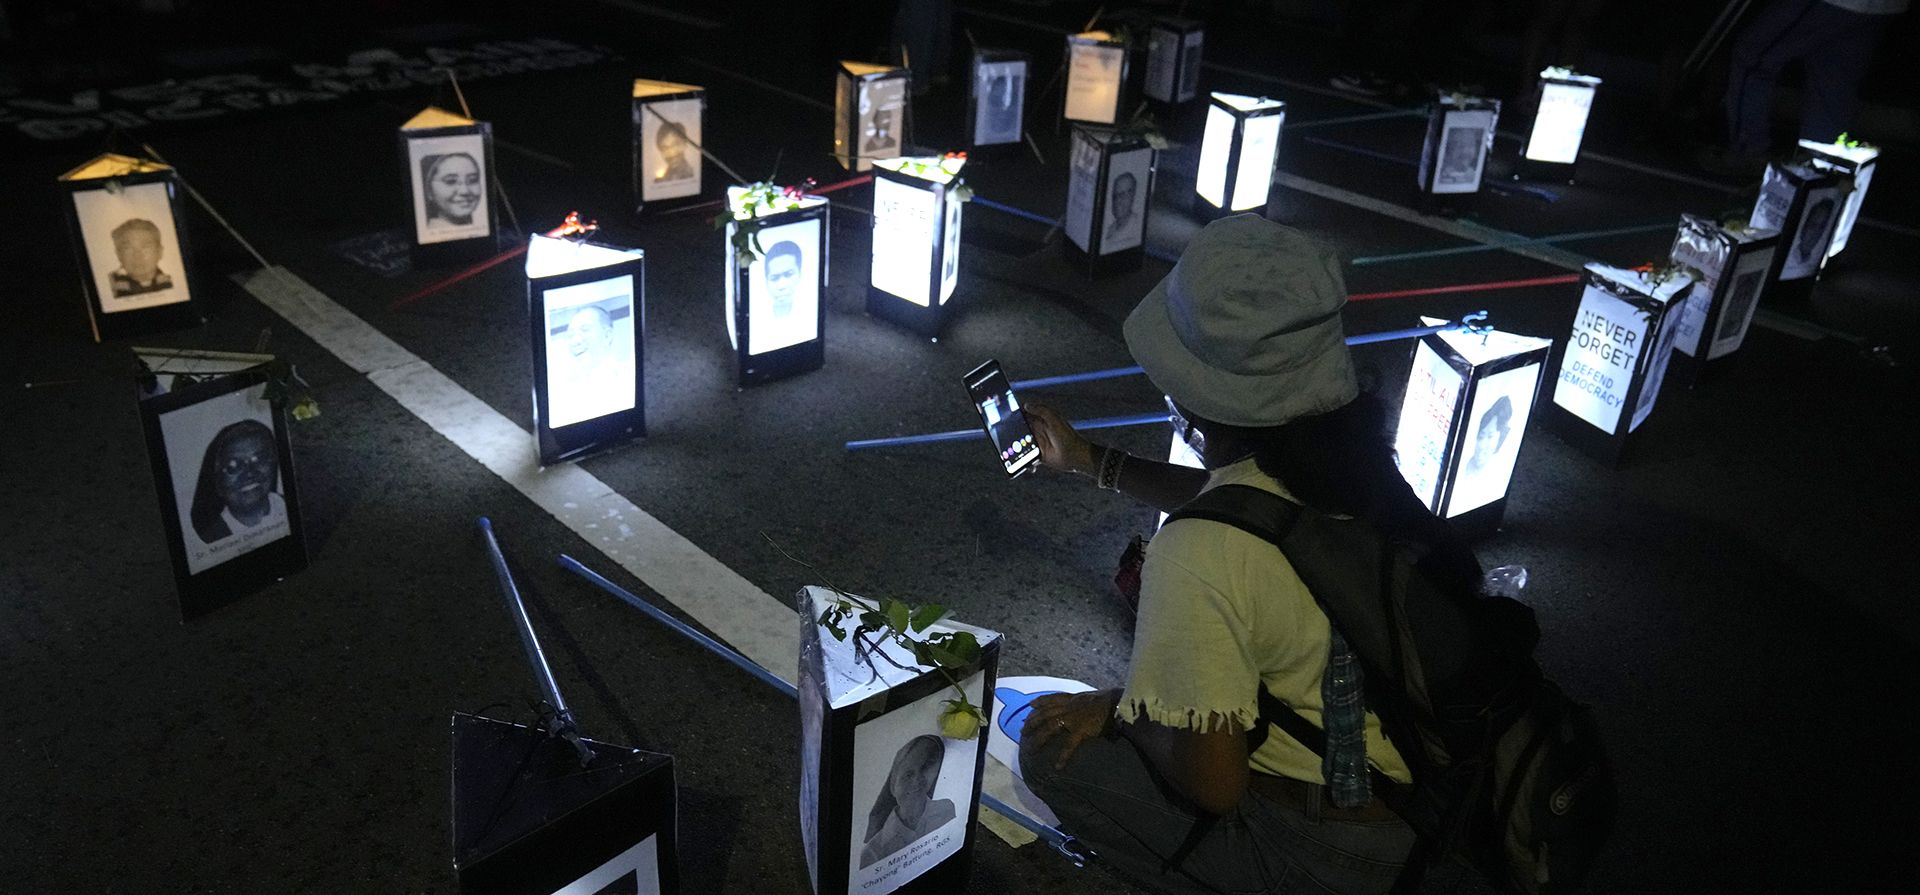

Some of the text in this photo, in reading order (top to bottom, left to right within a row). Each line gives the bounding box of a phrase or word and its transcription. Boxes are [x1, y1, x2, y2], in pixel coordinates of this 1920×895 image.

[1571, 327, 1634, 369] FORGET
[1582, 310, 1637, 349] NEVER
[1559, 368, 1622, 408] DEMOCRACY
[1572, 361, 1614, 389] DEFEND
[874, 835, 940, 876] Sr. Mary Rosario
